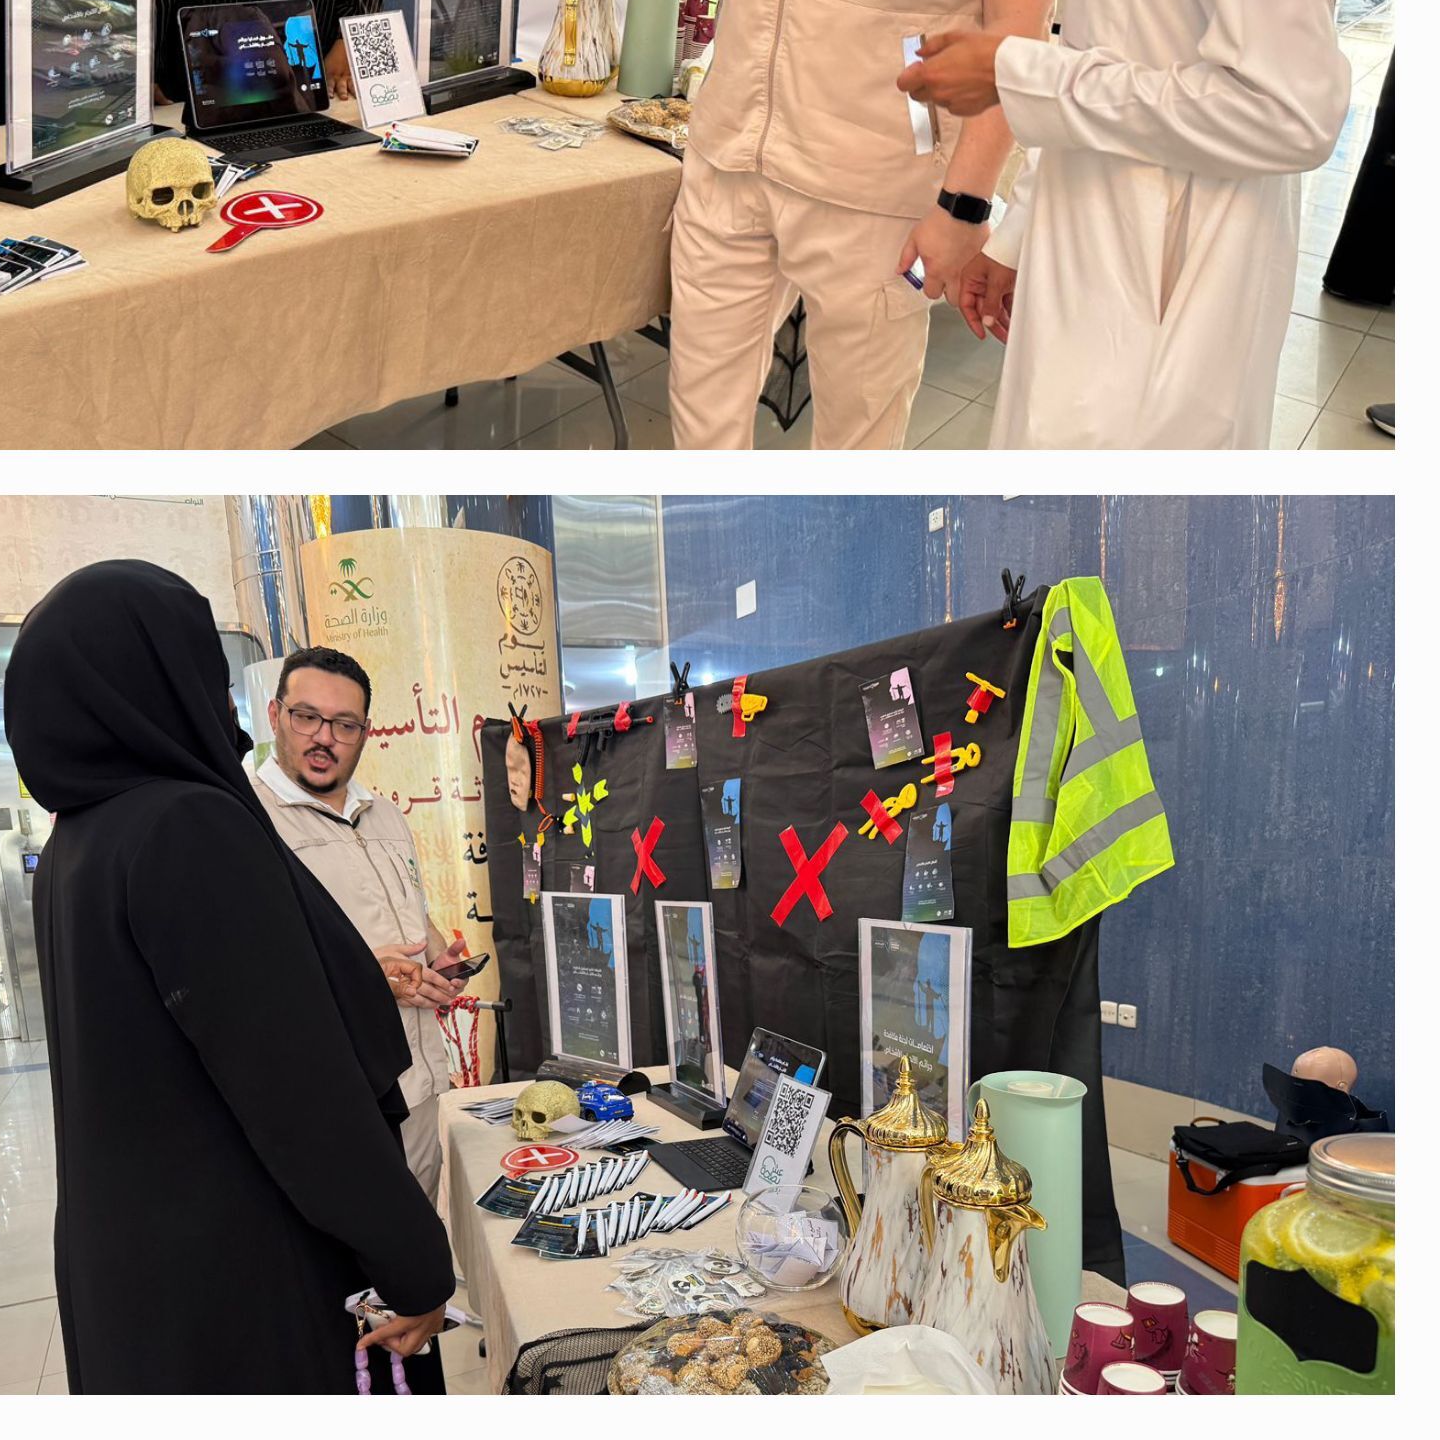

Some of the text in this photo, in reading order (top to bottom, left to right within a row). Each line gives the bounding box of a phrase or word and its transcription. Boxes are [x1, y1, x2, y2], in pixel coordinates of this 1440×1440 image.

[324, 605, 388, 629] وزارة الصحة
[352, 628, 362, 639] of
[363, 626, 389, 638] Health
[498, 633, 546, 656] يوم
